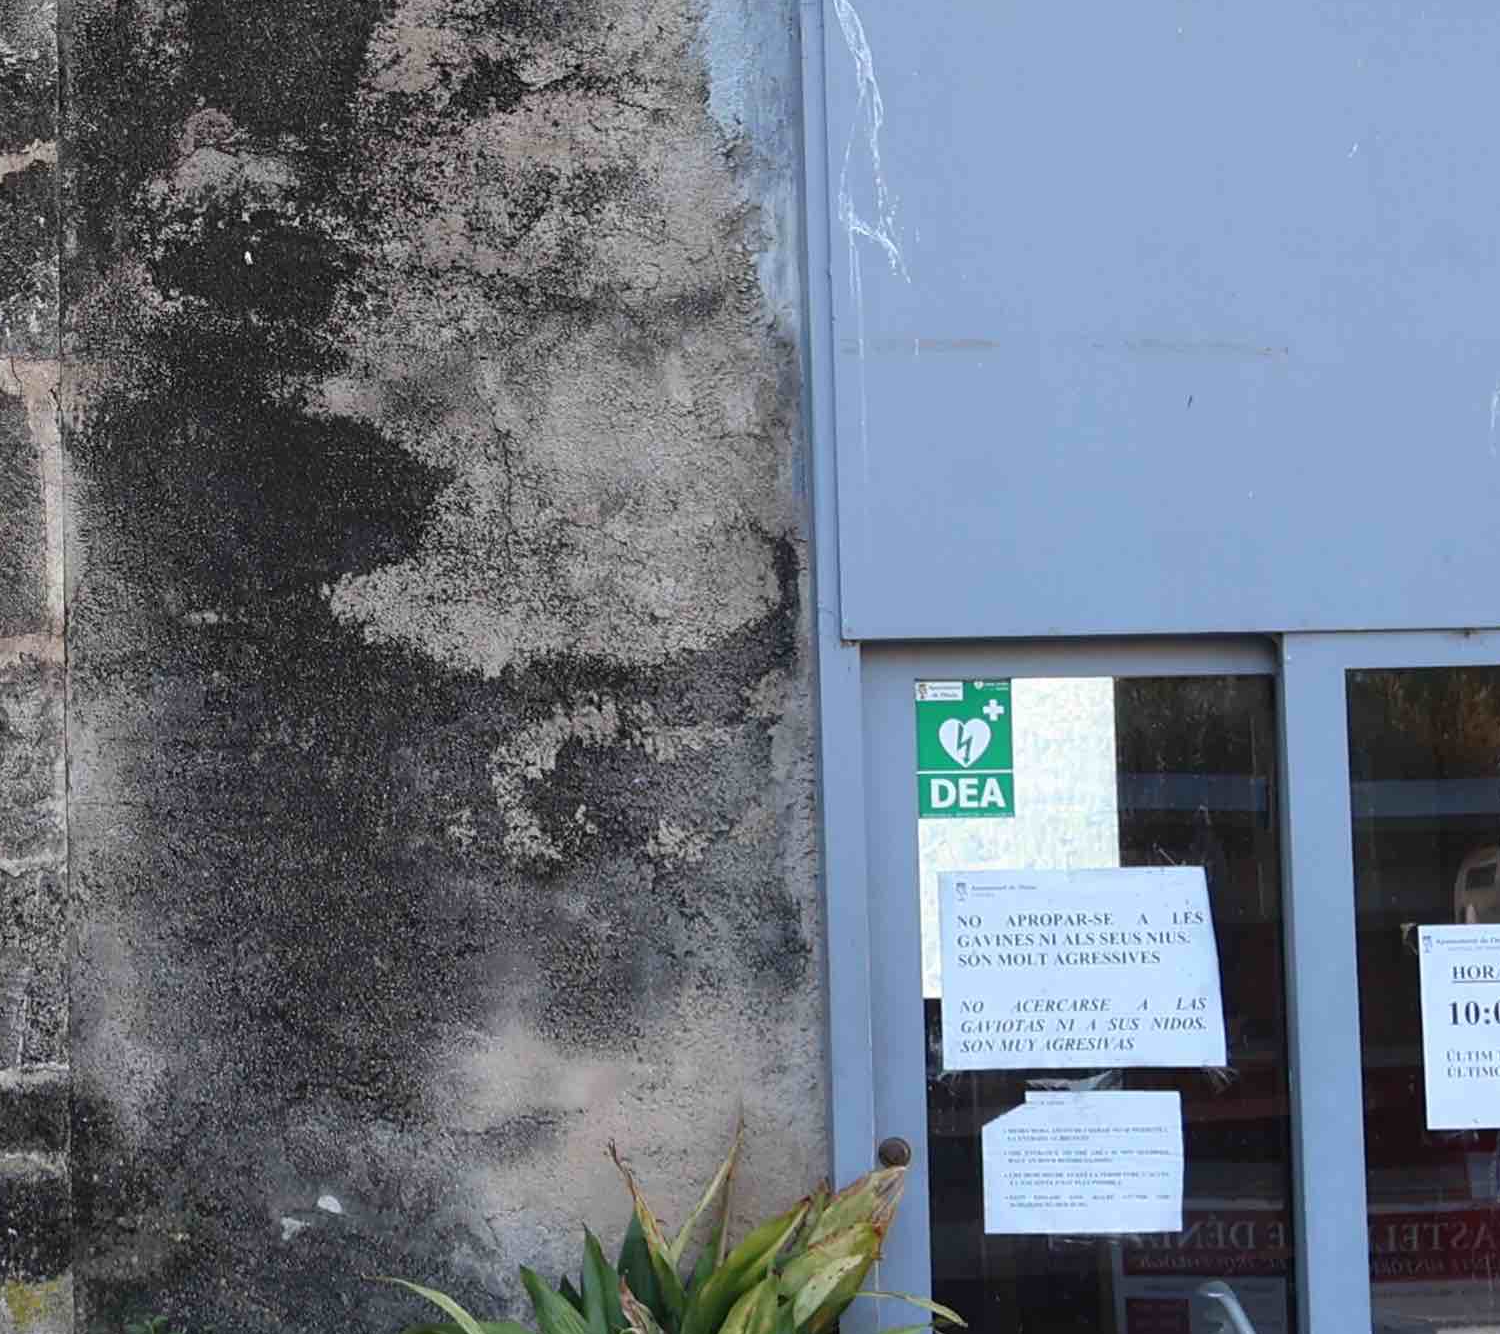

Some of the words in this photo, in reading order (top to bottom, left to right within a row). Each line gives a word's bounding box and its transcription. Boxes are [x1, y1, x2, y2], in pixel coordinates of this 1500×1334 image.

[930, 778, 1006, 808] DEA
[957, 915, 982, 928] NO
[1006, 912, 1113, 927] APROPAR-SE
[1138, 913, 1149, 925] A
[1172, 911, 1204, 924] LES
[957, 933, 1034, 948] GAVINES
[1040, 933, 1057, 946] NI
[1062, 932, 1095, 946] ALS
[1099, 931, 1142, 945] SEUS
[957, 949, 992, 967] SÓN
[998, 952, 1048, 966] MOLT
[1054, 950, 1161, 966] AGRESSIVES
[960, 1000, 984, 1013] NO
[1013, 998, 1111, 1012] ACERCARSE
[1137, 998, 1149, 1011] A
[1176, 997, 1207, 1010] LAS
[960, 1018, 1045, 1033] GAVIOTAS
[1056, 1018, 1074, 1032] NI
[1086, 1018, 1097, 1031] A
[1107, 1018, 1139, 1031] SUS
[1151, 1017, 1207, 1030] NIDOS.
[960, 1038, 994, 1053] SON
[1000, 1037, 1036, 1052] MUY
[1043, 1037, 1135, 1051] AGRESIVAS
